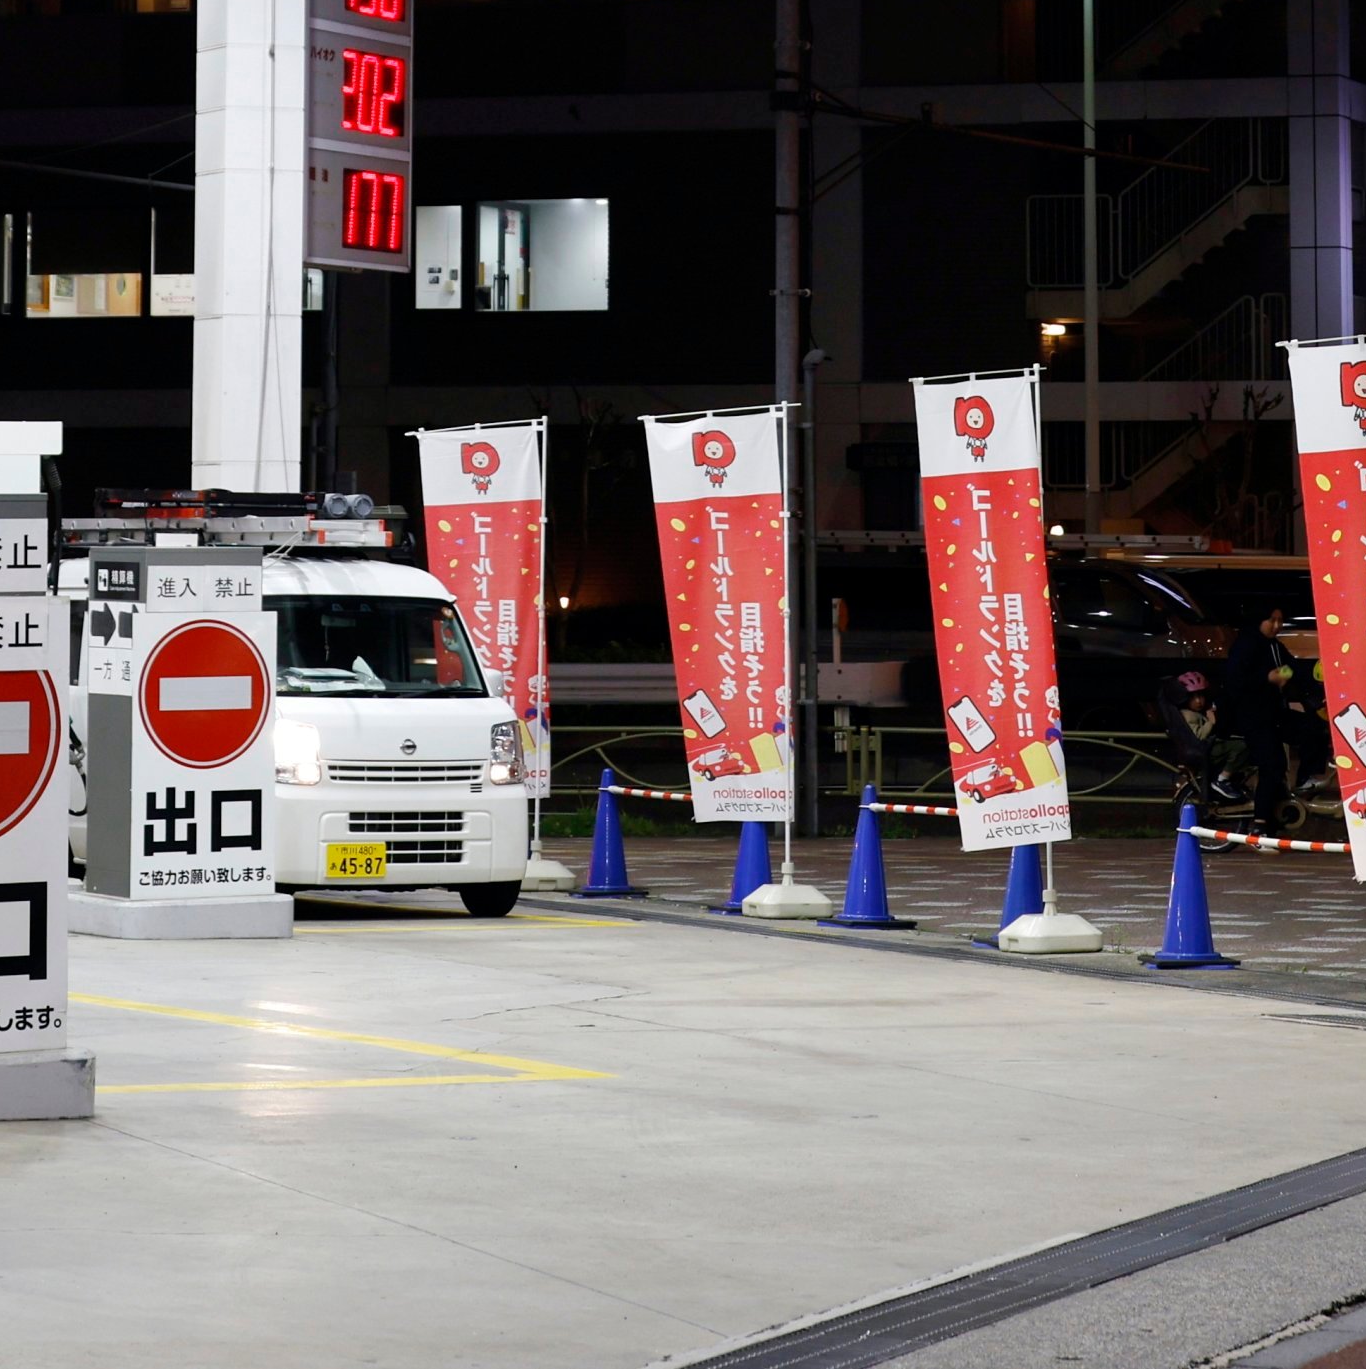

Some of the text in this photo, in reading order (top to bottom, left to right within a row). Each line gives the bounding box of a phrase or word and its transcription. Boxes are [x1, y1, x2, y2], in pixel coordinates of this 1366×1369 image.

[342, 49, 401, 136] 202
[346, 172, 401, 249] 177
[143, 786, 262, 857] 出口
[138, 866, 272, 888] ご協力お願い致します。
[339, 857, 383, 875] 45-87
